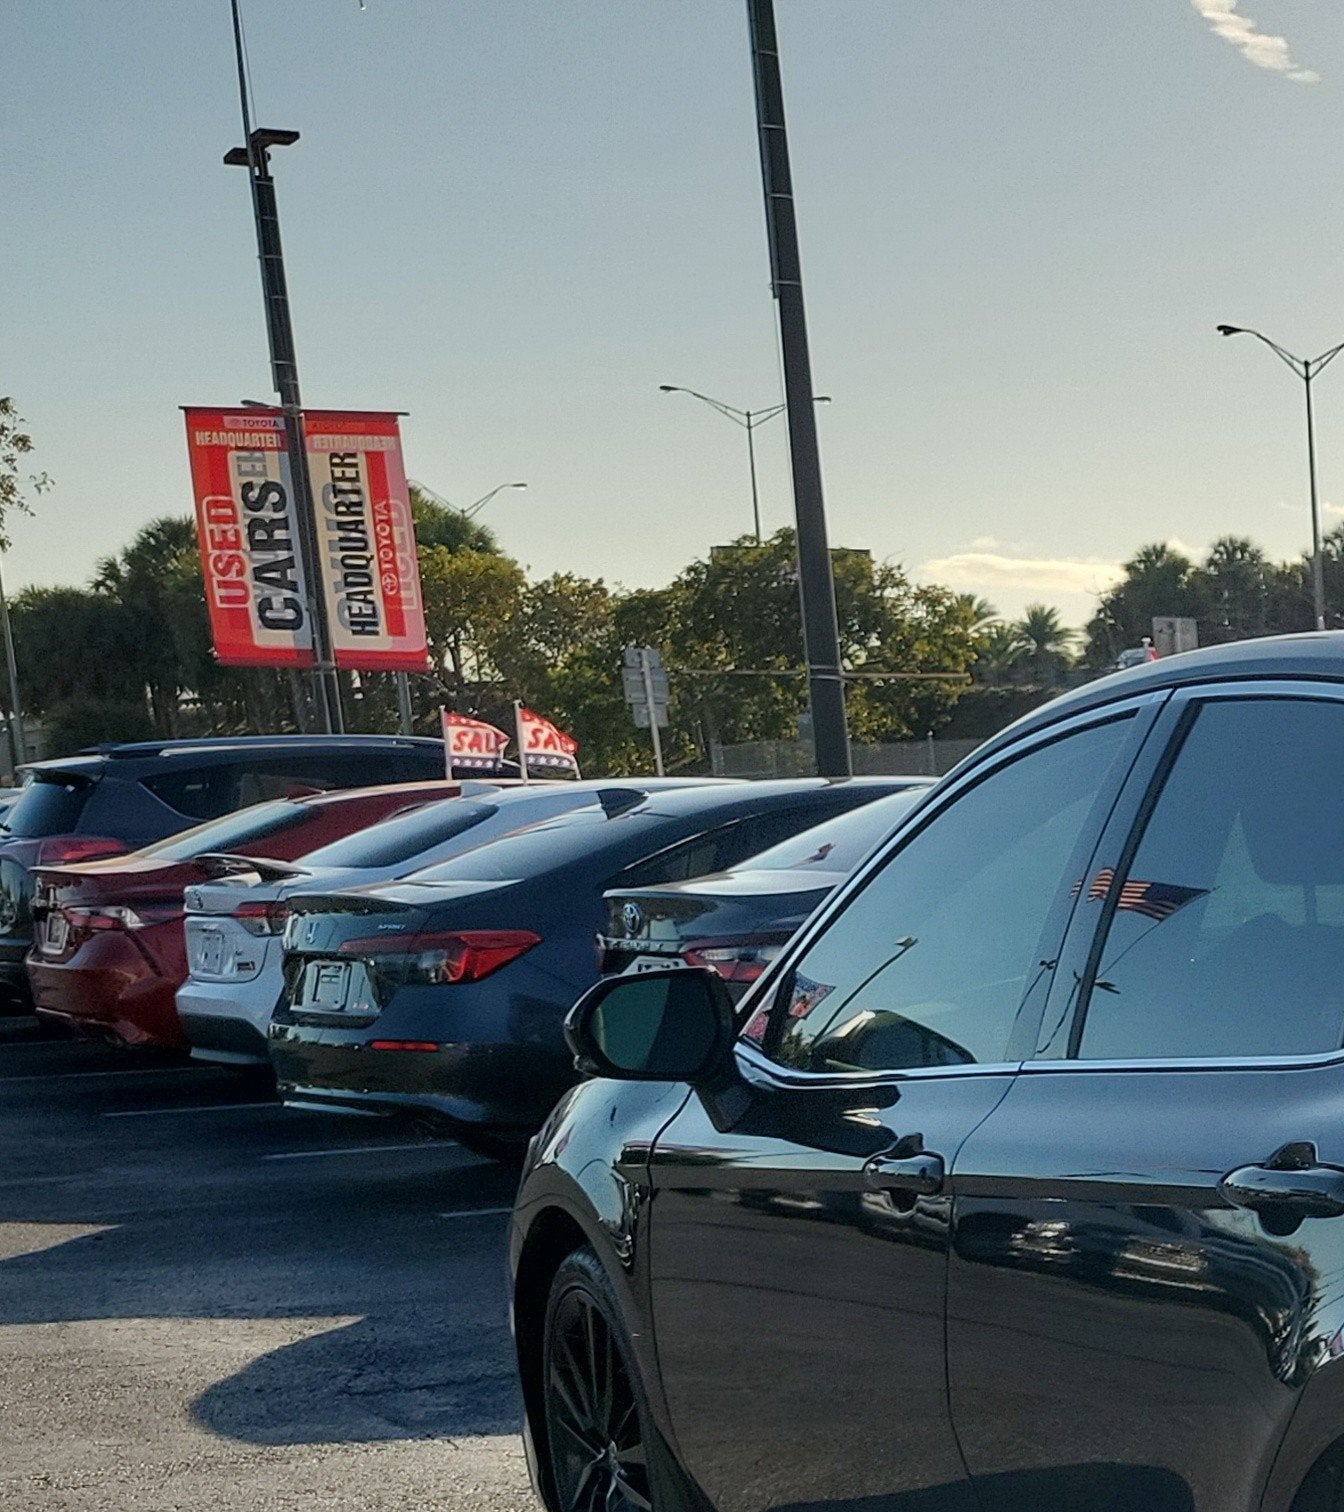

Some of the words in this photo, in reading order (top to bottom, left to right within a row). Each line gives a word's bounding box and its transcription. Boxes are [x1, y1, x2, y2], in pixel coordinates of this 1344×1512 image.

[195, 431, 281, 447] HEADQUARTER
[243, 419, 279, 428] TOYOTA
[203, 495, 249, 608] USED
[241, 480, 303, 630] CARS
[329, 451, 380, 636] HEADQUARTER
[375, 501, 394, 564] TOYOTA
[453, 731, 498, 752] SAL
